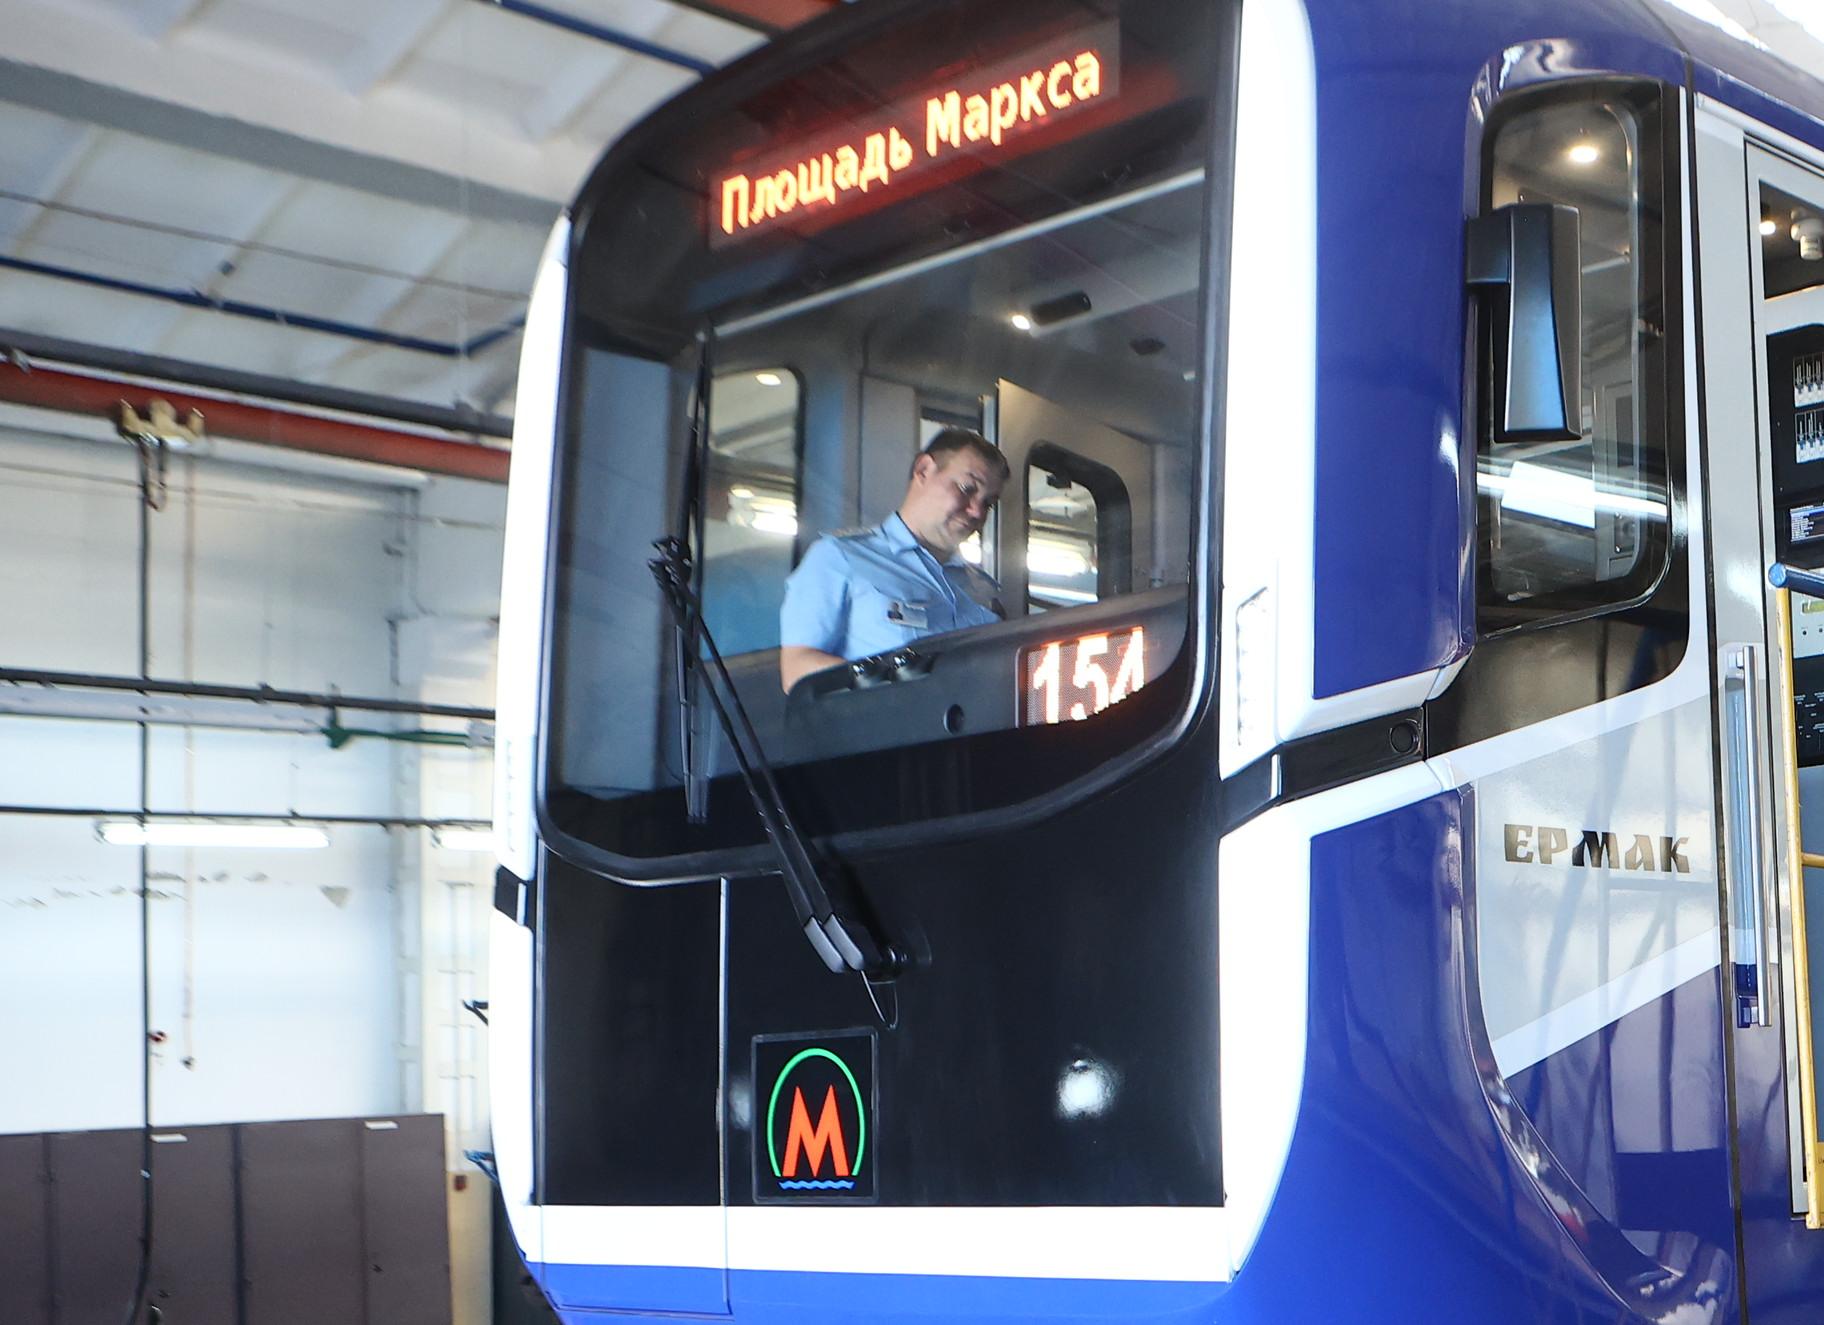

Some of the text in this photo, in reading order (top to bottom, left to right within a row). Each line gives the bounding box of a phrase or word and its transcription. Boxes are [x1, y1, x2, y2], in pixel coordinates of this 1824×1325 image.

[721, 50, 1100, 234] Площадь Маркса
[1504, 823, 1690, 873] ЕРМАК
